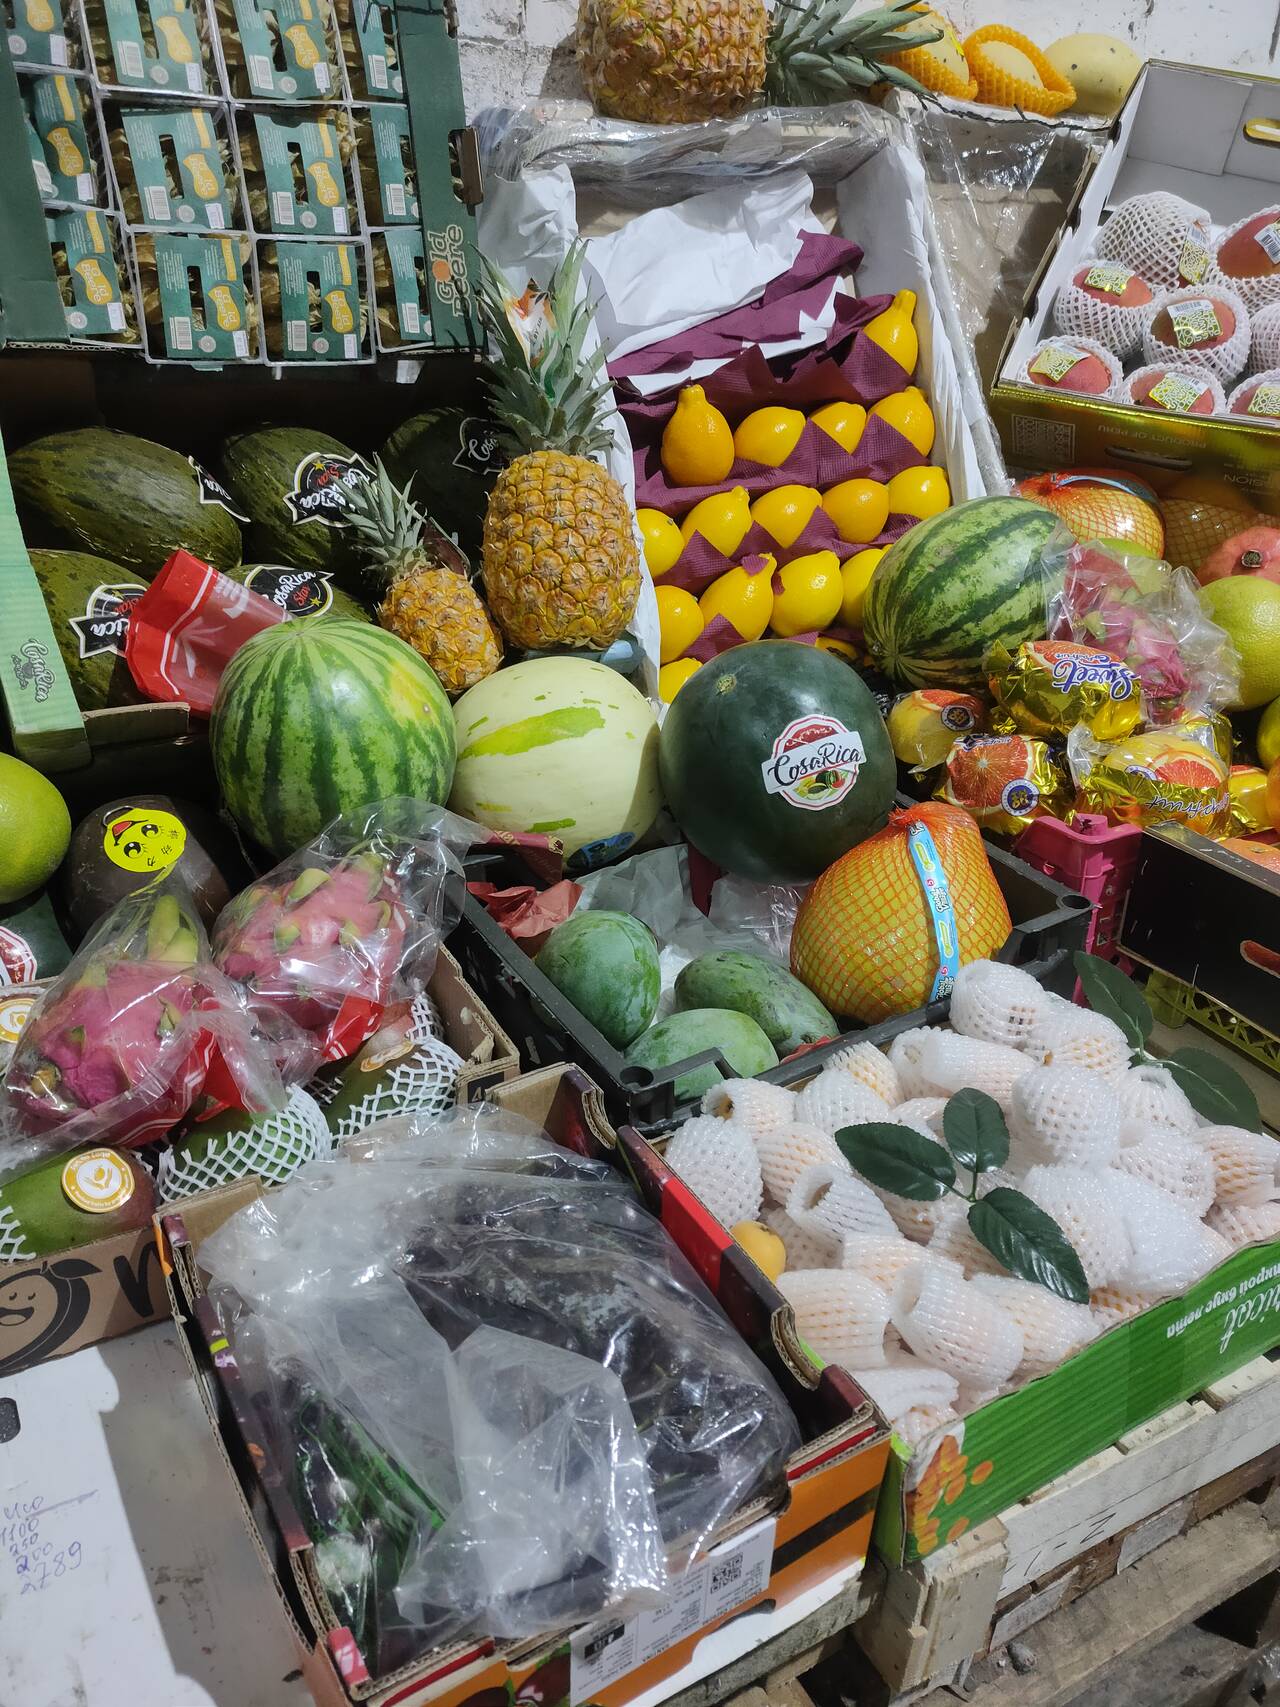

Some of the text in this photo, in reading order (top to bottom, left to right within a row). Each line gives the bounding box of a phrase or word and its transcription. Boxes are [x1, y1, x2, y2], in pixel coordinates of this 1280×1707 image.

[1052, 658, 1140, 701] Sweet
[765, 740, 862, 787] CosaRica
[1202, 1284, 1237, 1314] вкус
[1166, 1305, 1202, 1338] лета
